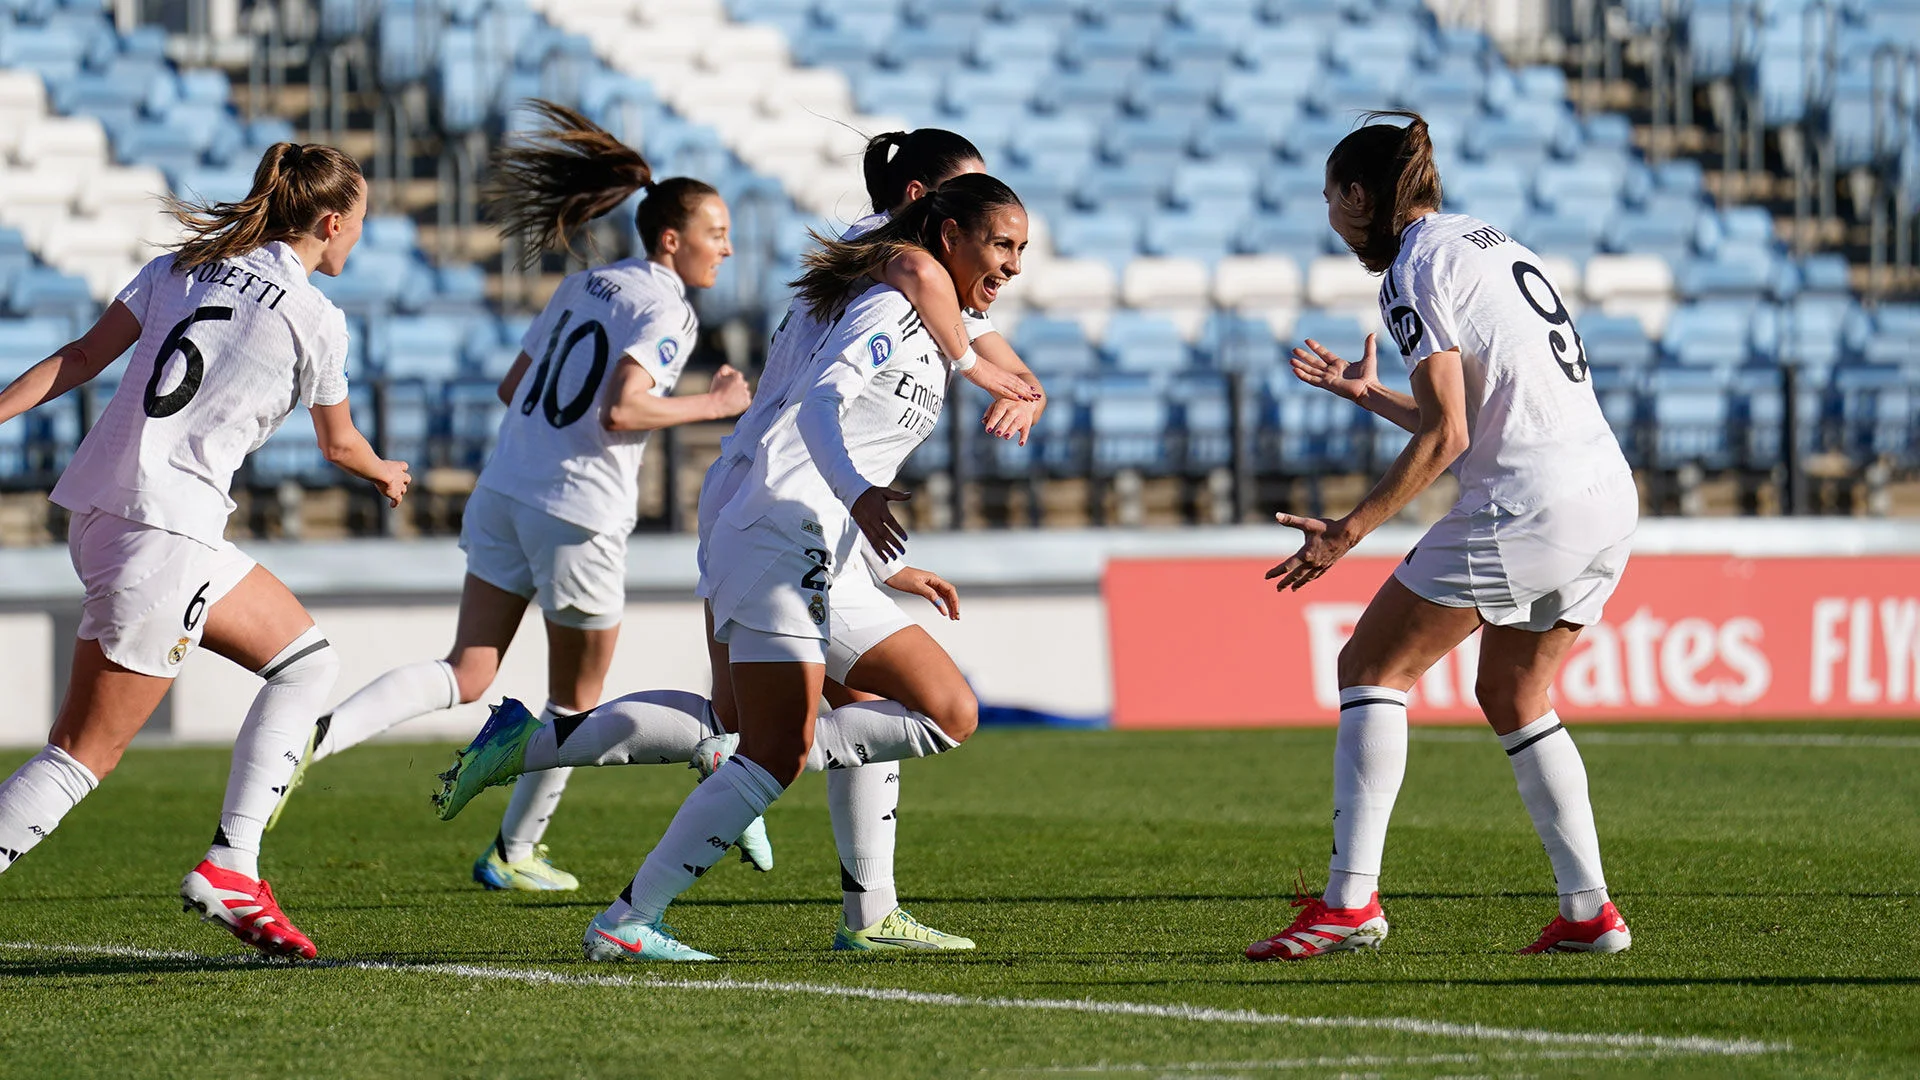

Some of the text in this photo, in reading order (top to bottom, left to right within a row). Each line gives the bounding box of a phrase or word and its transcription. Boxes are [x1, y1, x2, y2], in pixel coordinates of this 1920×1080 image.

[1462, 225, 1514, 249] BRU
[1512, 261, 1588, 383] 9
[143, 305, 234, 418] 6
[521, 309, 609, 429] 10
[898, 407, 922, 431] FLY
[801, 548, 832, 592] 2
[183, 580, 210, 631] 6
